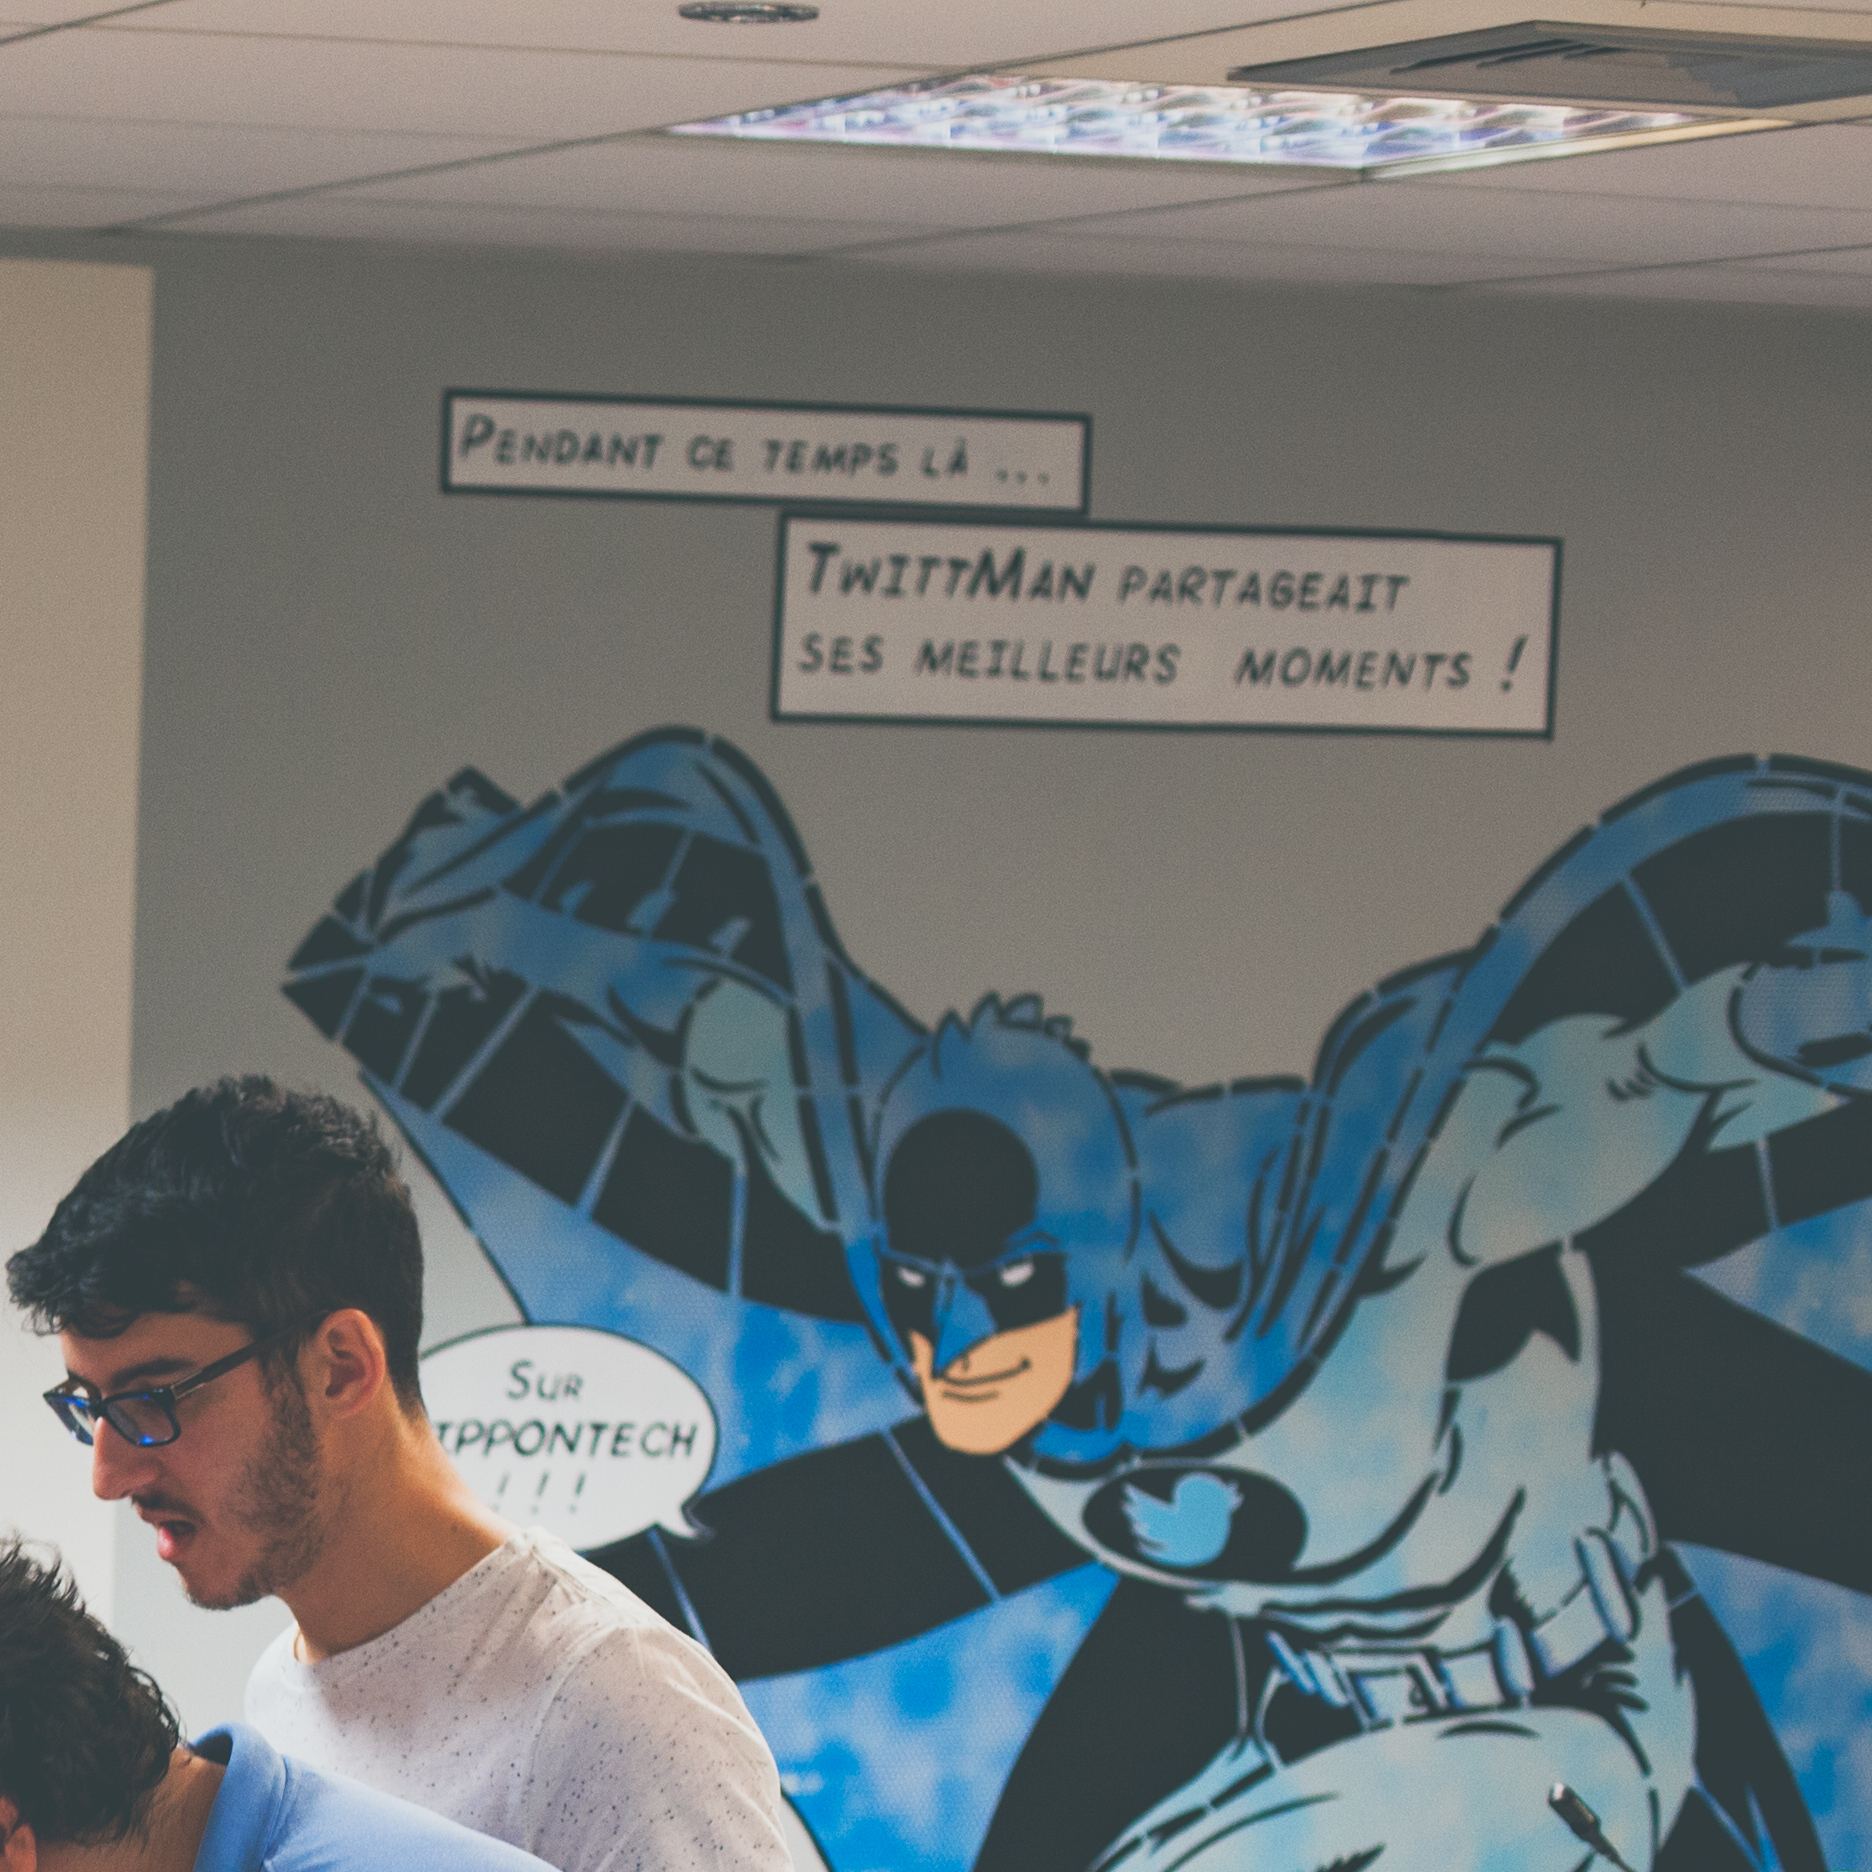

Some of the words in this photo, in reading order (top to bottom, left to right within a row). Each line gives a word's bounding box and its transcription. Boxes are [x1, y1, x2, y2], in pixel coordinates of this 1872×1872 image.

[460, 412, 664, 470] PENDANT
[686, 434, 735, 472] CE
[762, 438, 901, 478] TEMPS
[806, 541, 1096, 601] TWITTMAN
[1118, 563, 1411, 613] PARTAGEAIT
[798, 631, 886, 674] SES
[914, 636, 1183, 685] MEILLEURS
[1234, 647, 1475, 692] MOMENTS
[506, 1359, 585, 1400] SUR
